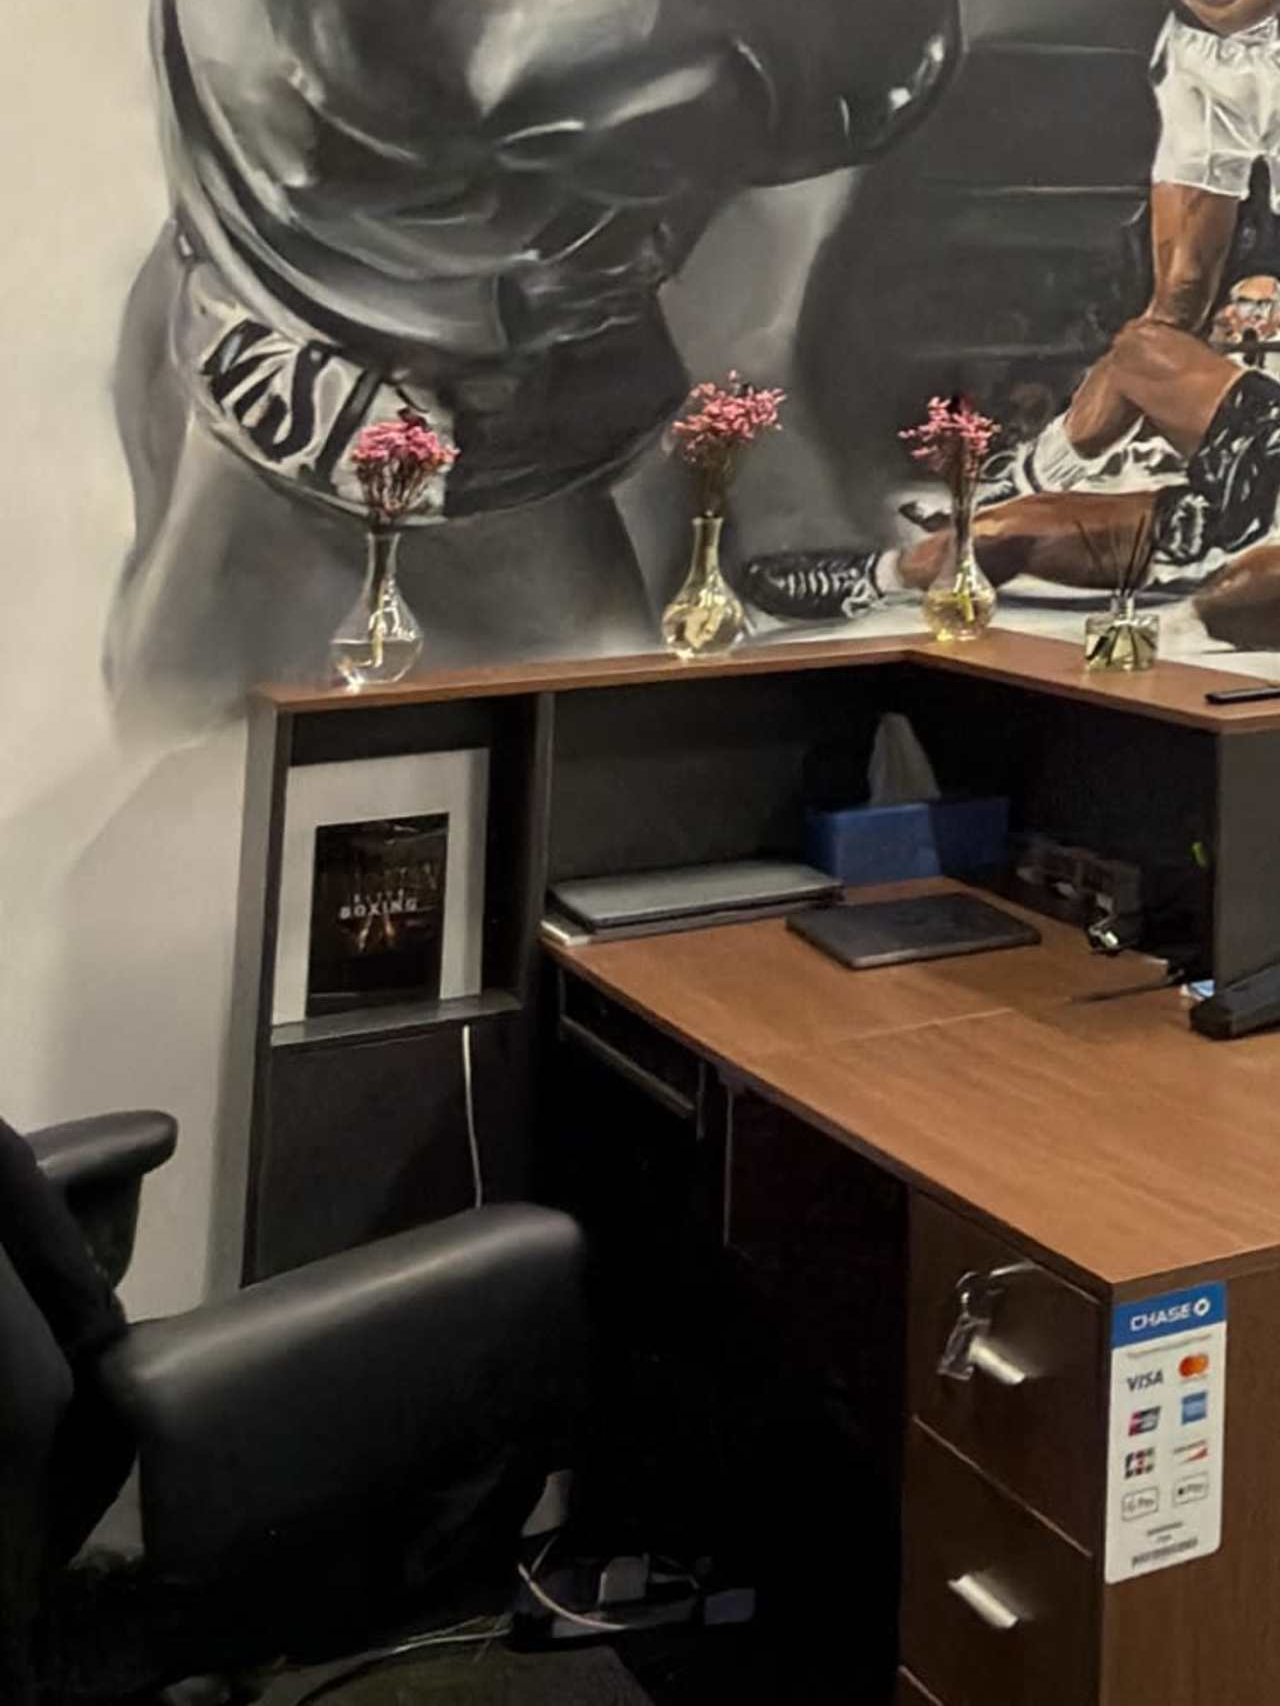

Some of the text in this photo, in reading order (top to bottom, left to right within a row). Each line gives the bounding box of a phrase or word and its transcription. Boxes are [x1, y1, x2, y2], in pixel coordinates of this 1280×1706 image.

[338, 897, 418, 920] BOXING
[1130, 1302, 1192, 1332] CHASE
[1126, 1369, 1164, 1392] VISA
